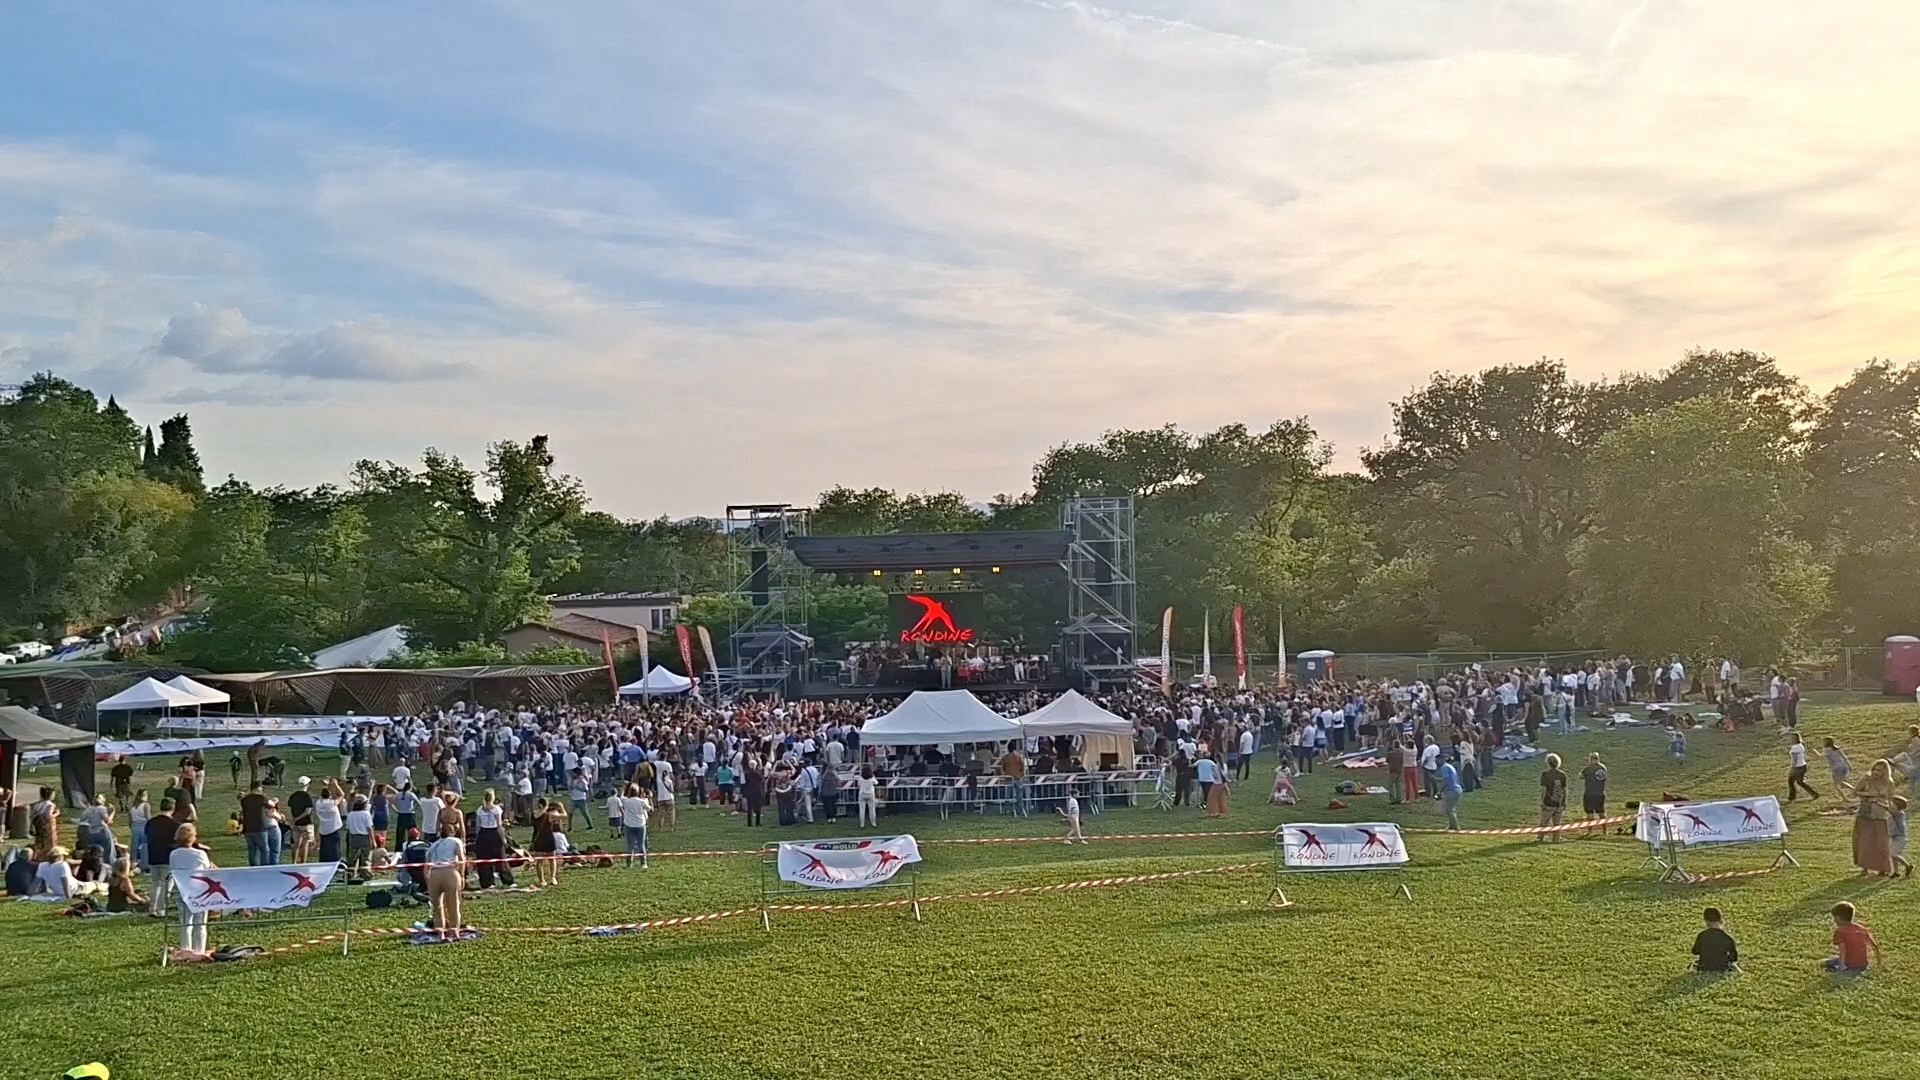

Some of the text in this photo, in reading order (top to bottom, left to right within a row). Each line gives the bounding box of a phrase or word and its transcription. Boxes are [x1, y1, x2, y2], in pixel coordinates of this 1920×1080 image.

[901, 629, 973, 642] RONDINE
[1290, 852, 1336, 860] RONDINE
[1353, 849, 1401, 860] RONDINE
[188, 896, 245, 908] ONDINE
